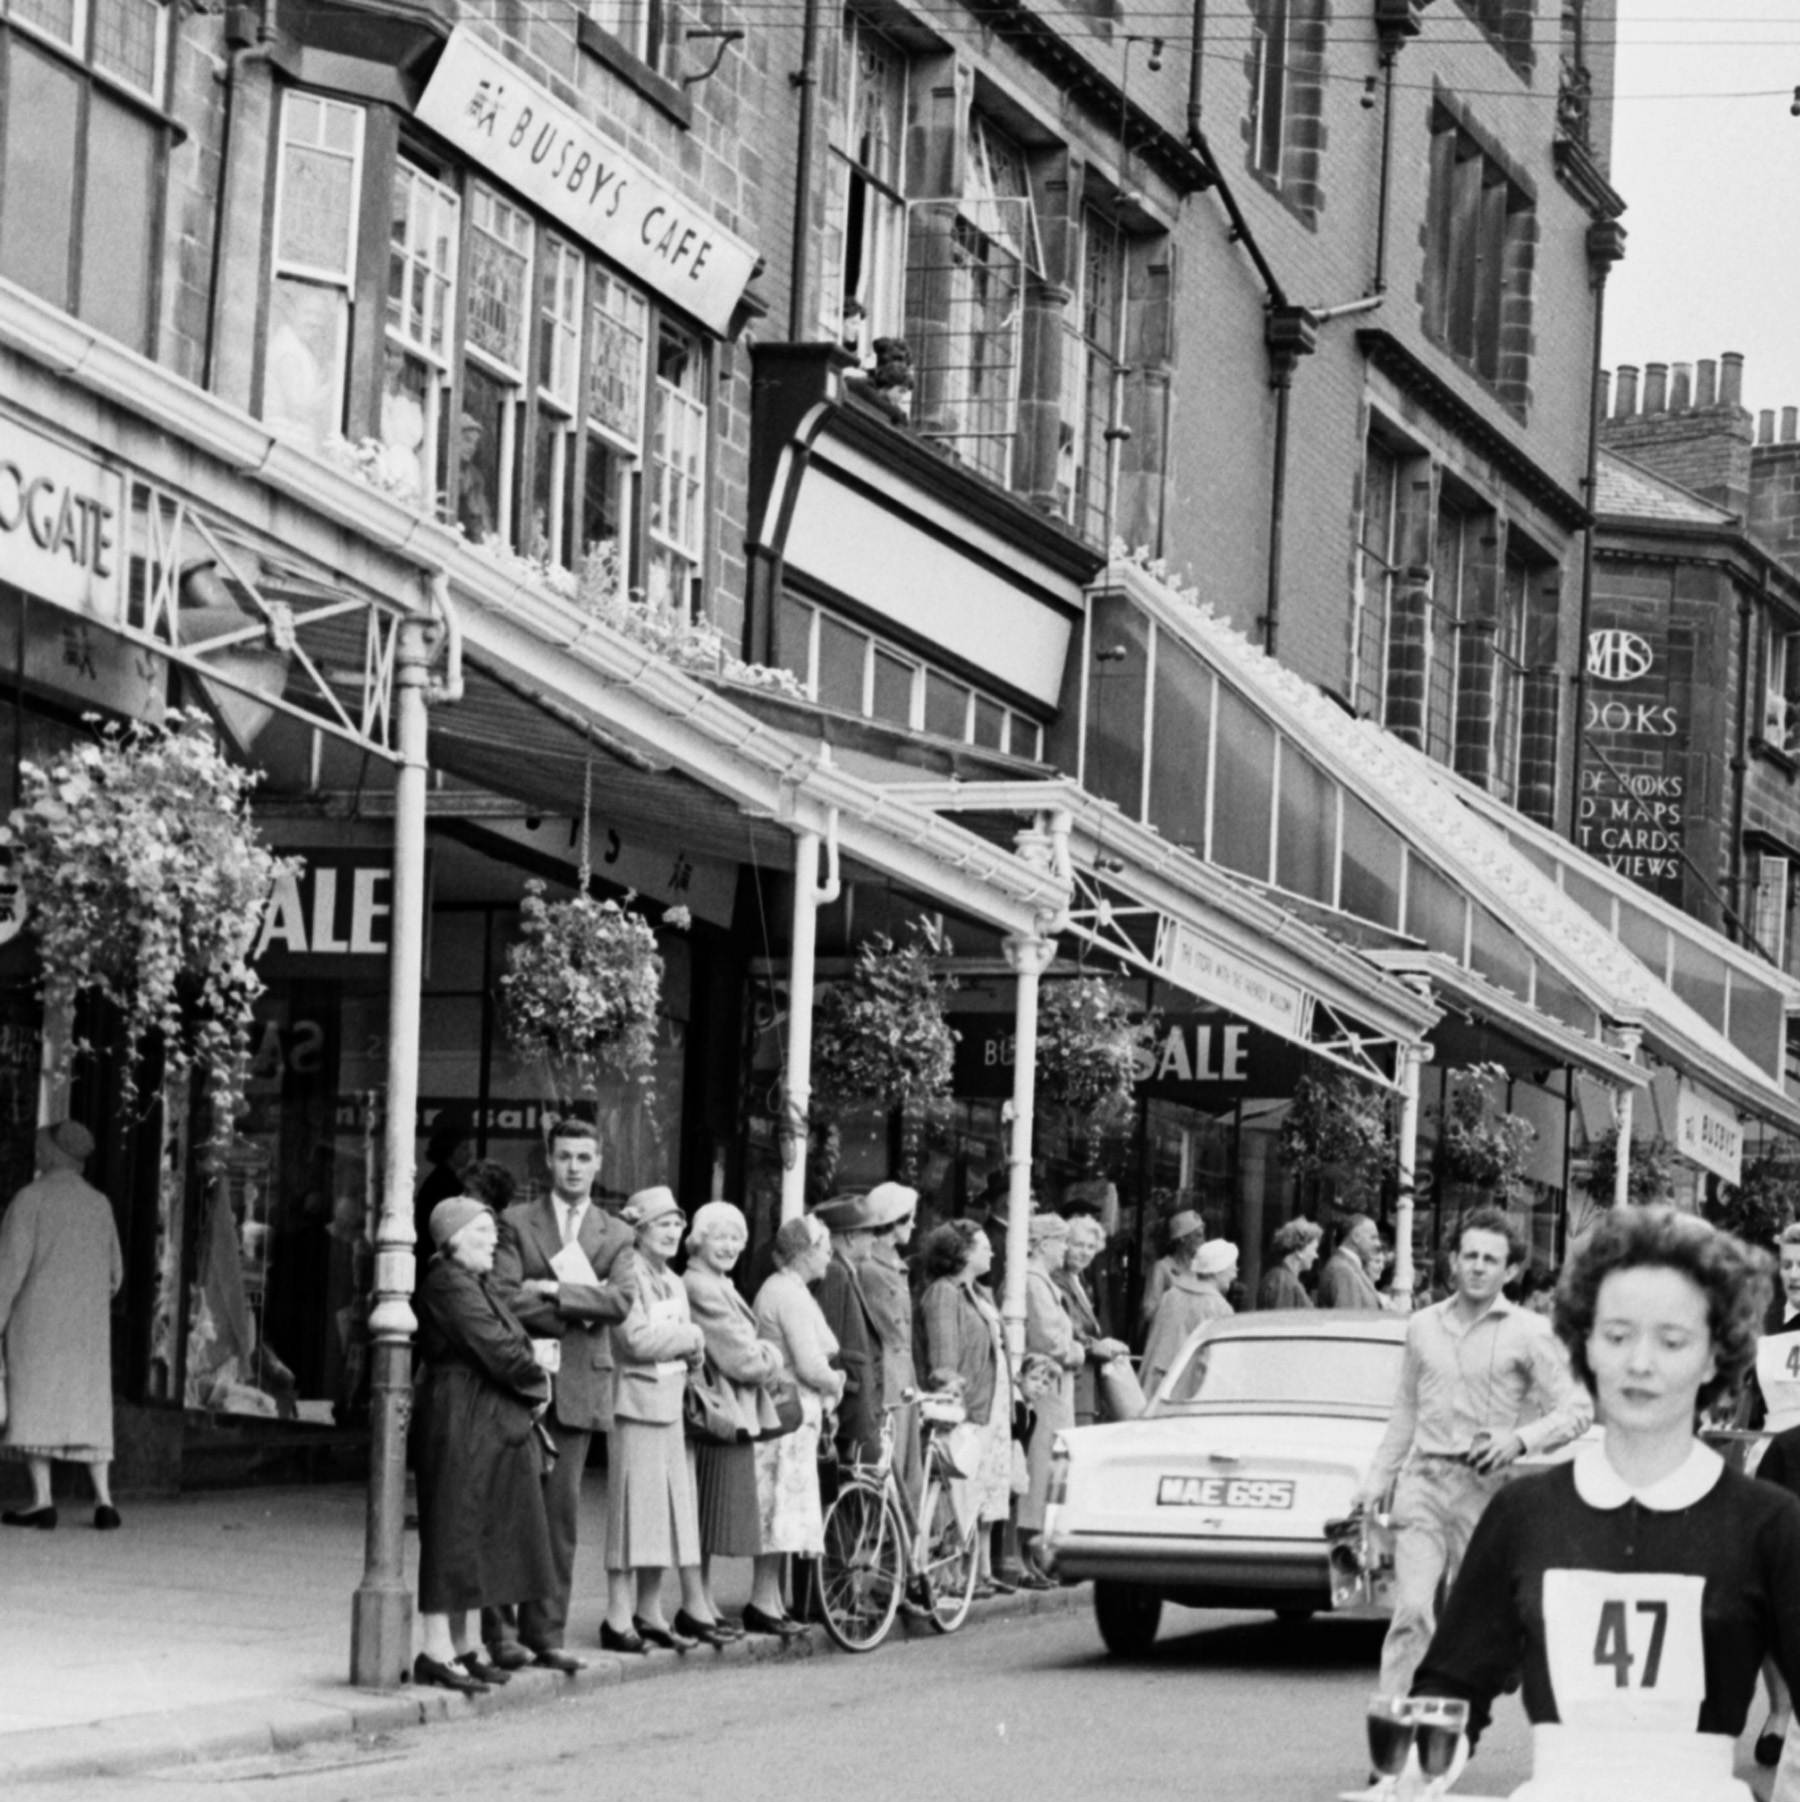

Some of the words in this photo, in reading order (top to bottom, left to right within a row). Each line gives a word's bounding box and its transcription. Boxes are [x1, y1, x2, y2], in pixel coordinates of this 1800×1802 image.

[508, 106, 627, 218] BUSBYS
[641, 206, 712, 281] CAFE
[1610, 799, 1681, 825] MAPS
[1601, 828, 1681, 854] CARDS
[1607, 854, 1678, 880] VIEWS
[254, 867, 391, 954] ALE
[1227, 1481, 1293, 1509] 695
[1594, 1601, 1667, 1688] 47
